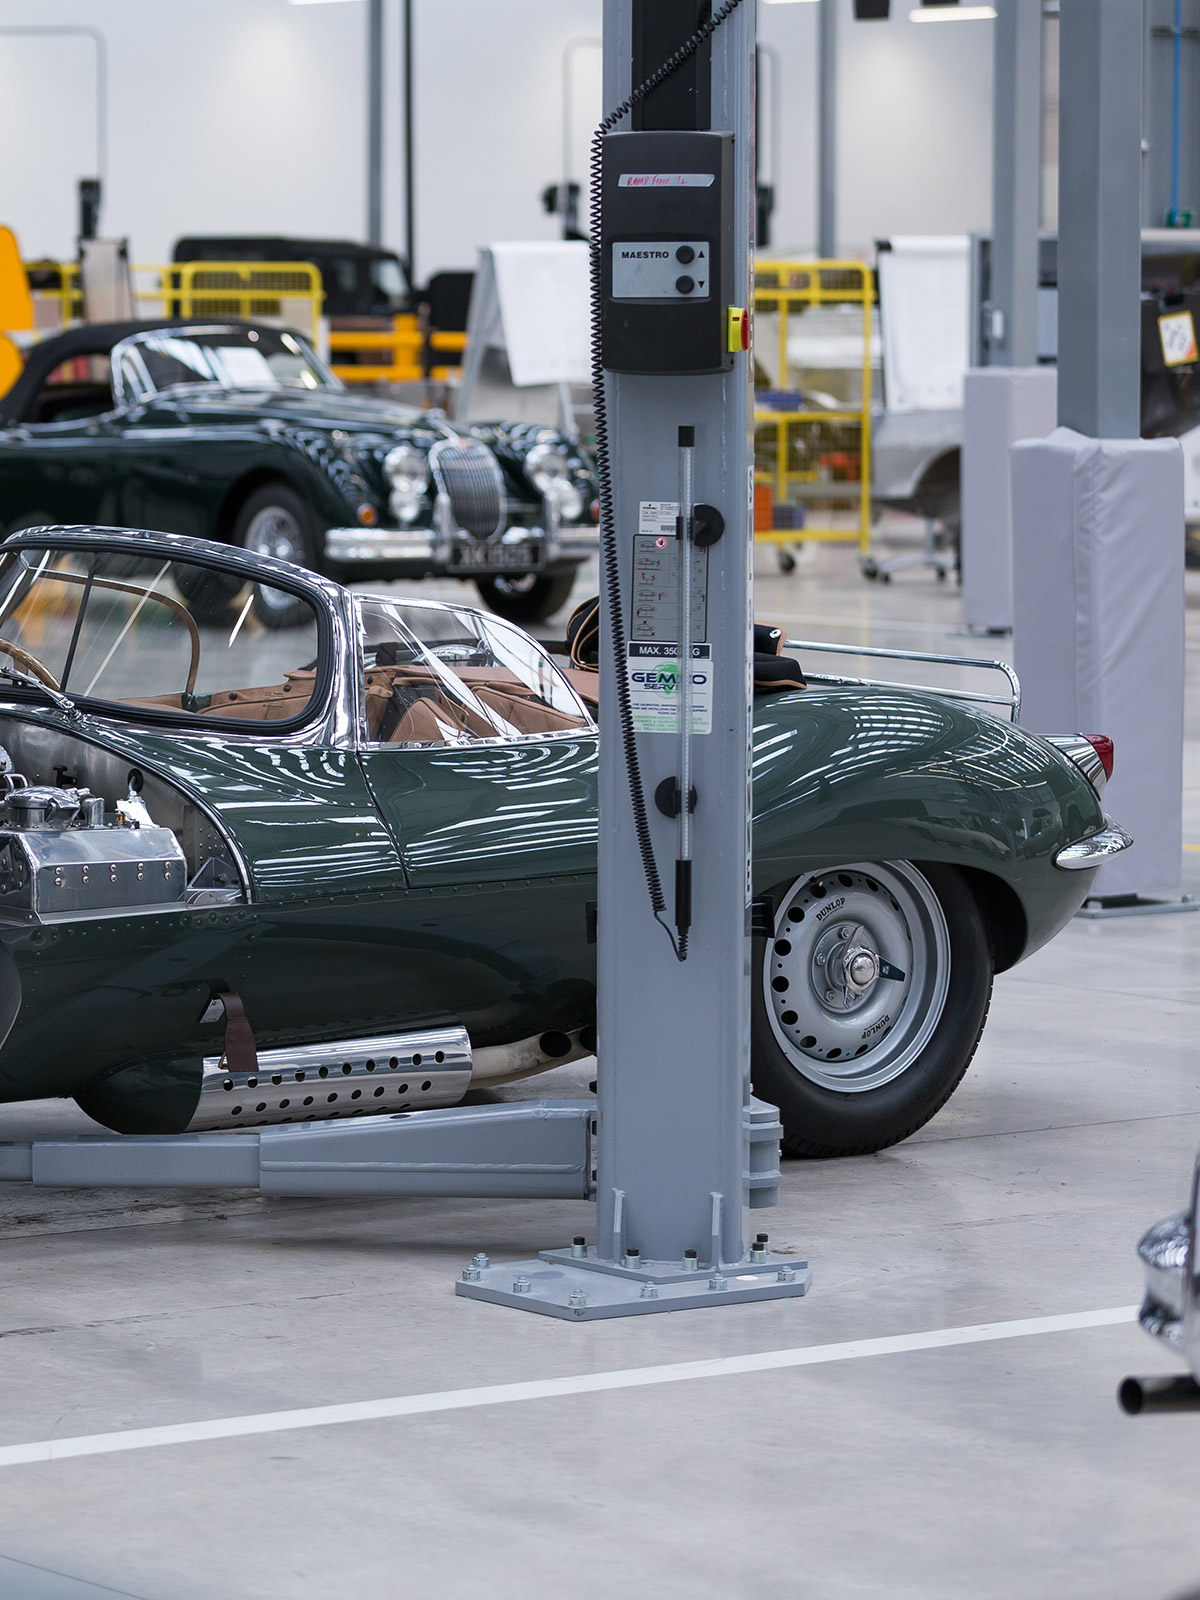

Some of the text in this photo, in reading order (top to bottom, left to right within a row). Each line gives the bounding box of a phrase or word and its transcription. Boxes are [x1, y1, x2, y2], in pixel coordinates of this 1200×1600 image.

[621, 251, 669, 259] MAESTRO
[639, 646, 662, 655] MAX.
[631, 672, 707, 685] GEMO
[815, 897, 846, 921] DUNLOP
[861, 1014, 890, 1039] DUNLOP
